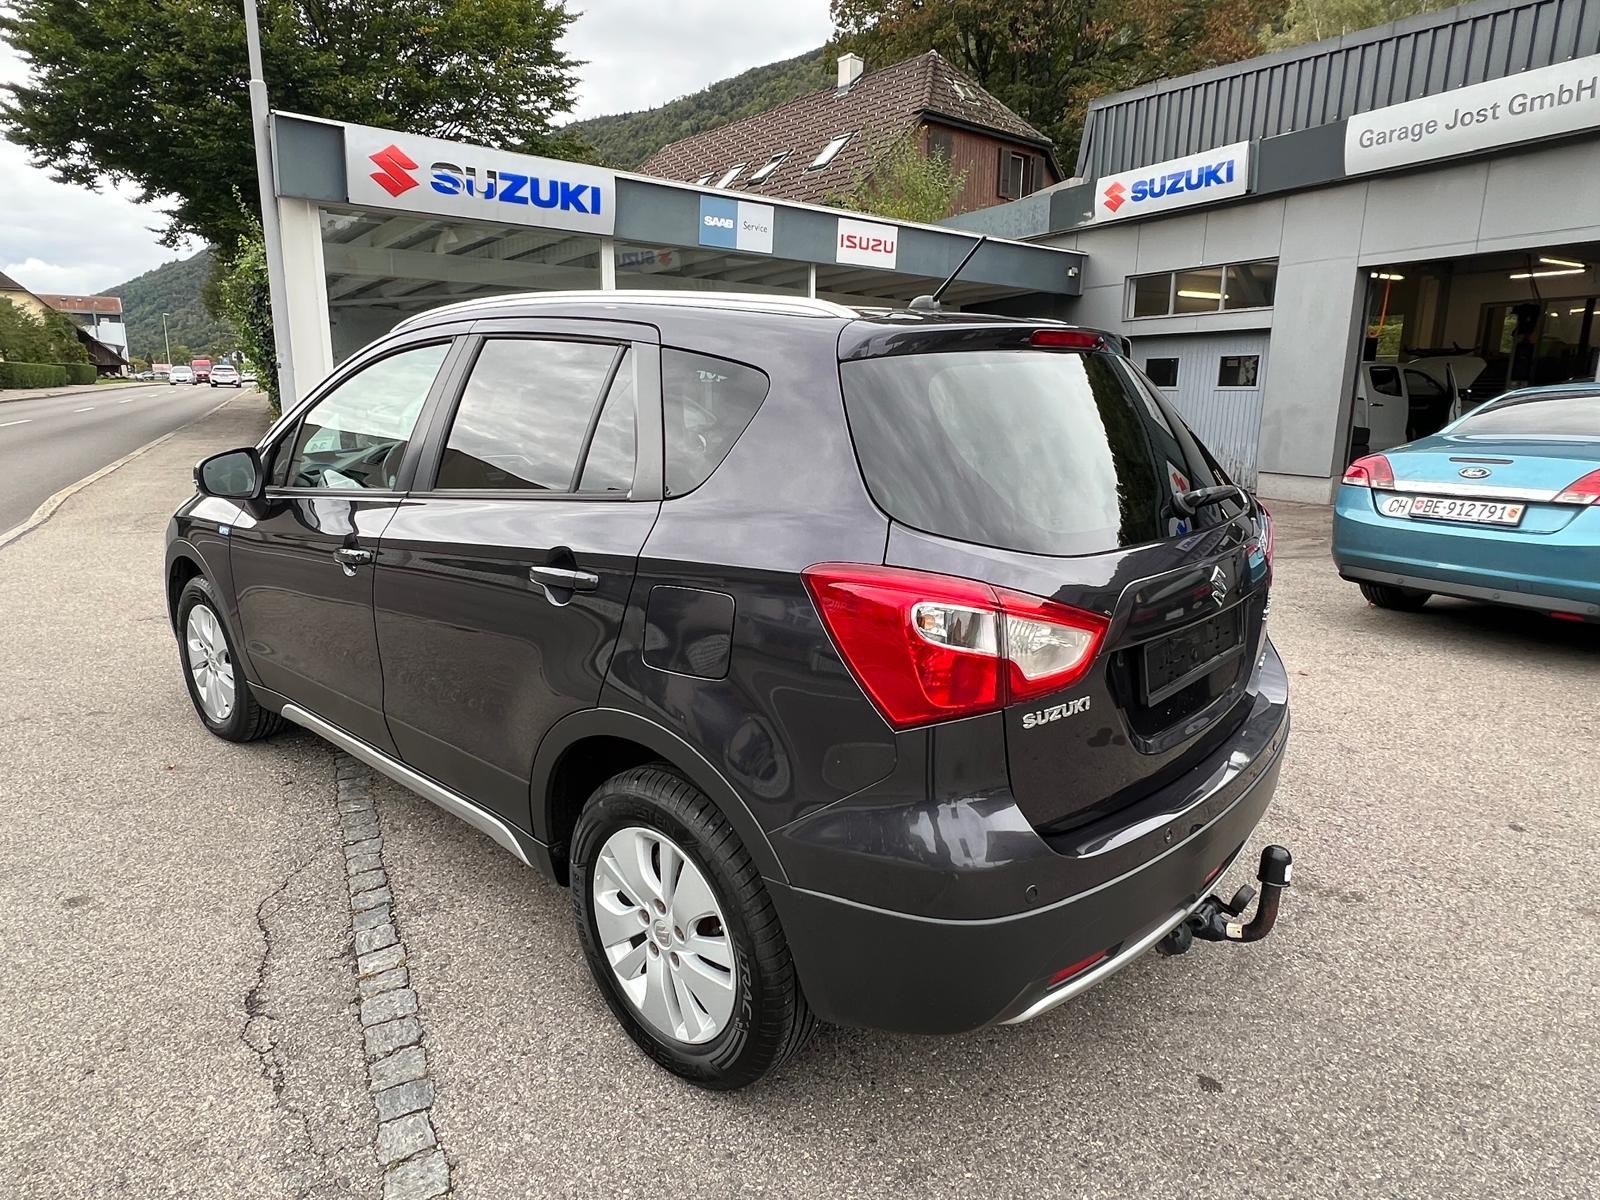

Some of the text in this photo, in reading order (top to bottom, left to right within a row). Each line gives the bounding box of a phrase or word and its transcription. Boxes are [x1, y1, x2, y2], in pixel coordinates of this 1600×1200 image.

[1359, 76, 1598, 149] Garage Jost GmbH
[429, 161, 601, 215] SUZUKI
[1131, 159, 1235, 203] SUZUKI
[704, 215, 768, 233] SAAB Service
[840, 234, 894, 254] ISUZU
[1388, 499, 1409, 513] CH
[1022, 695, 1091, 730] SUZUKI
